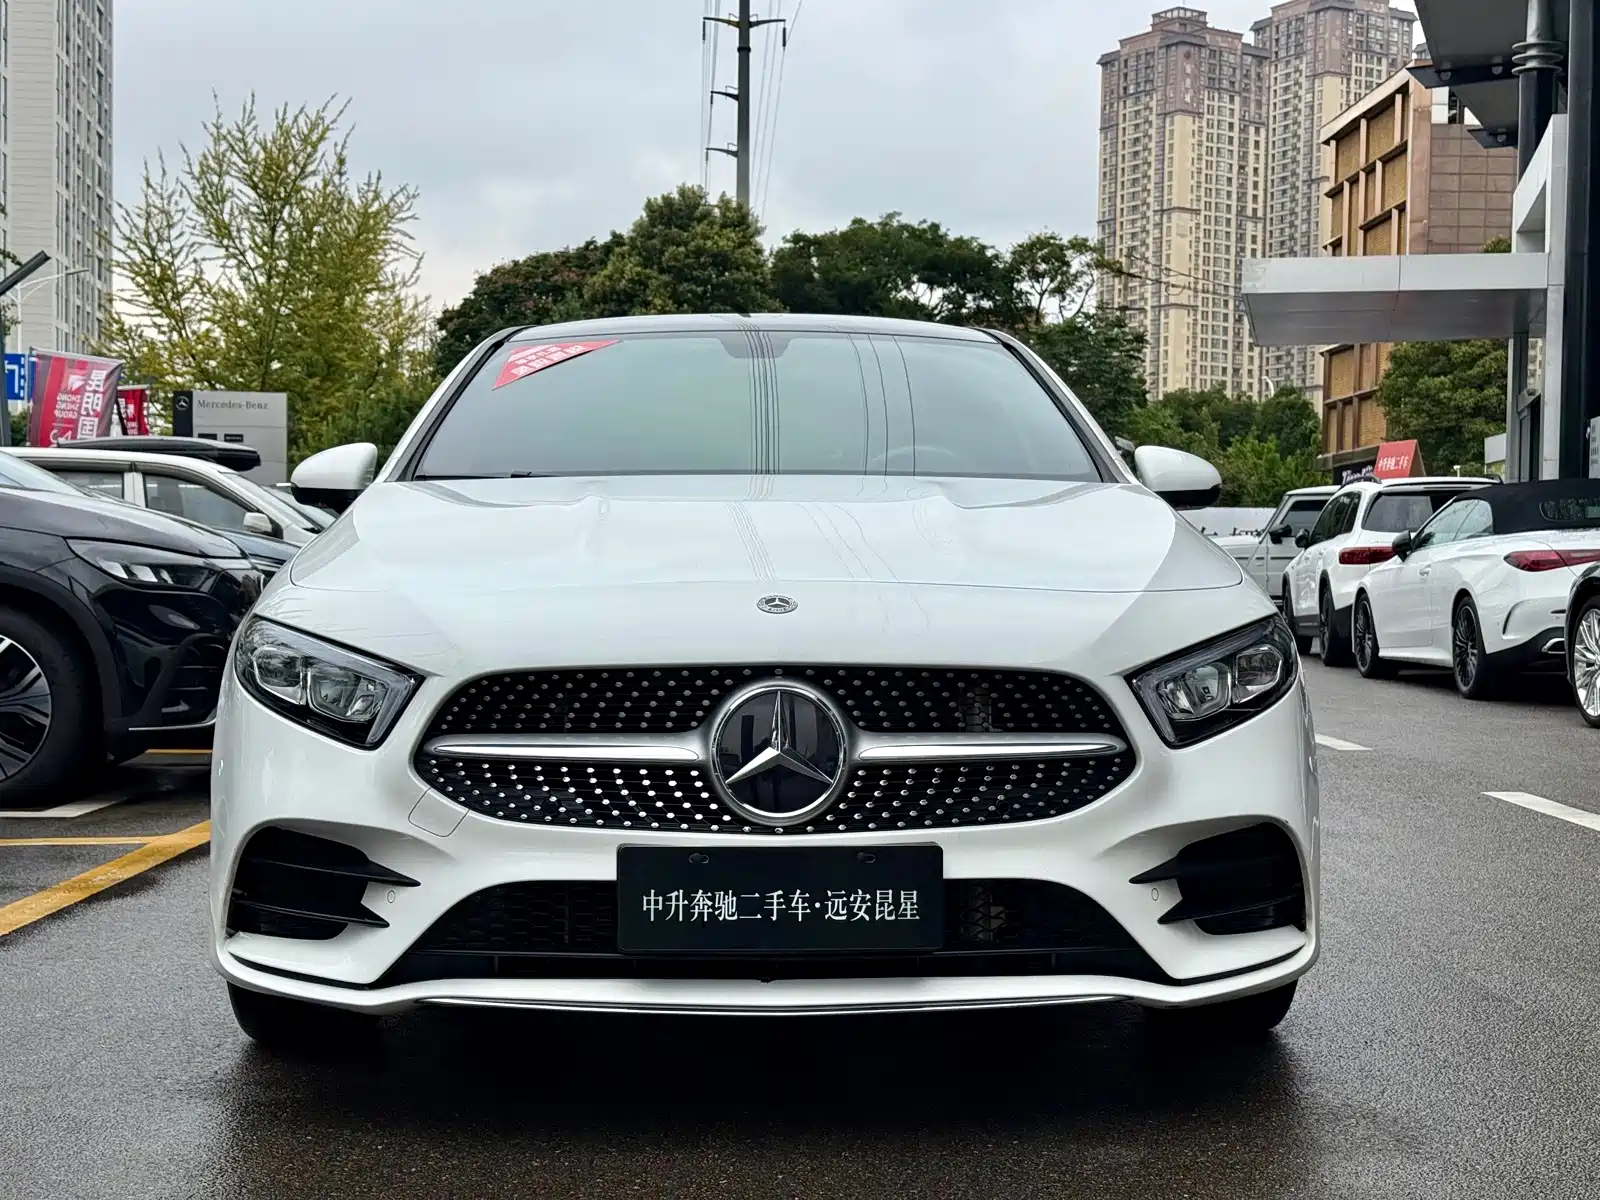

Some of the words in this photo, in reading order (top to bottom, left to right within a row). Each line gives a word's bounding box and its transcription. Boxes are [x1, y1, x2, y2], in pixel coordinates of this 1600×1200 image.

[197, 399, 269, 410] Mercedes-Benz
[642, 889, 920, 922] 中升奔驰二手车·远安昆星
